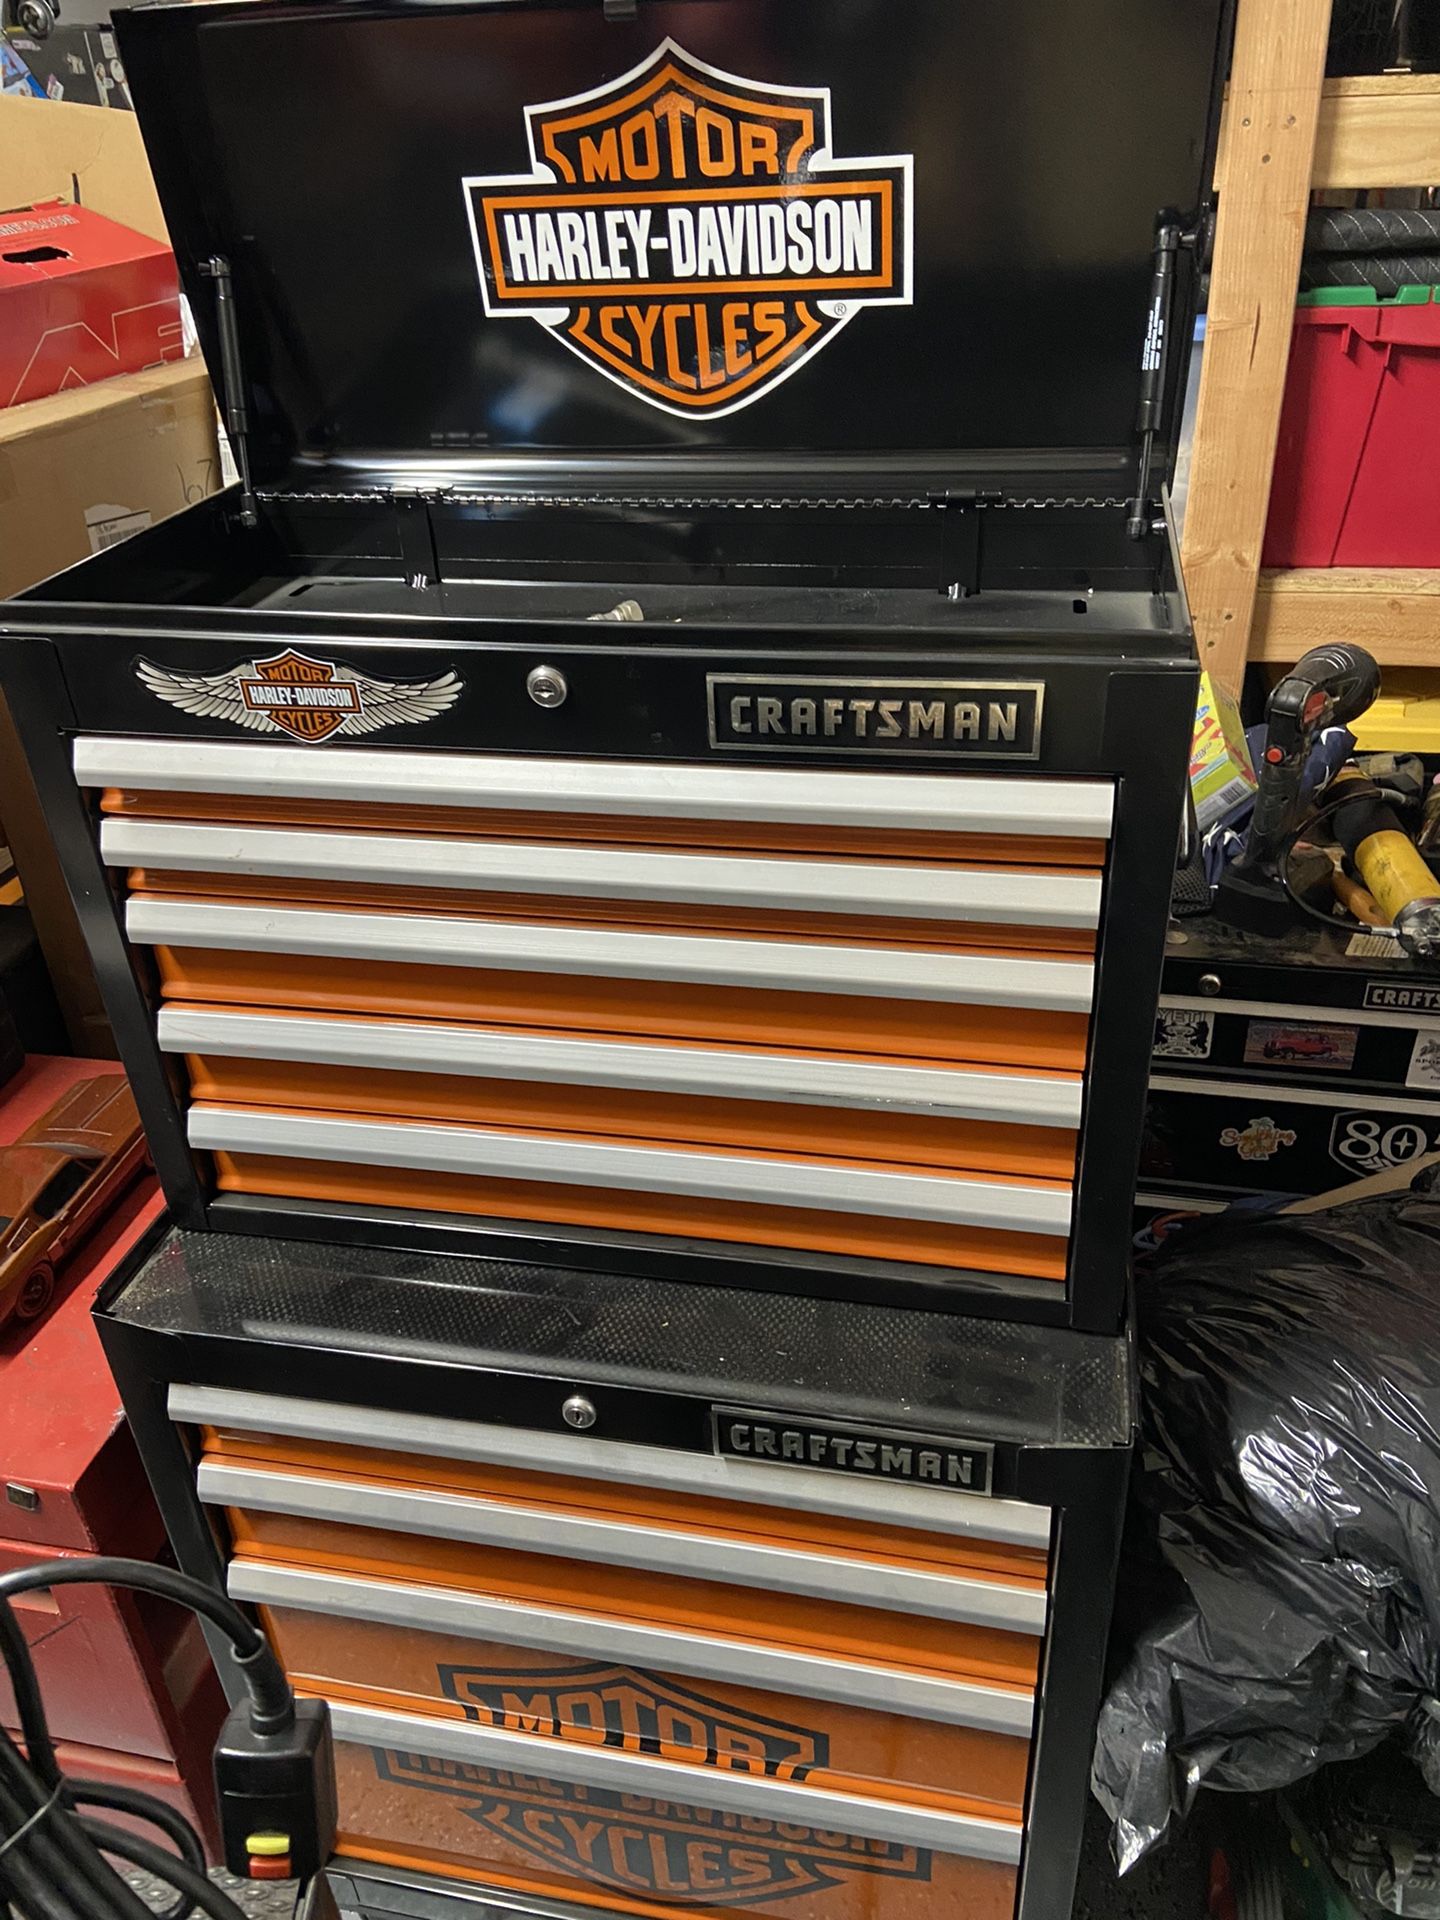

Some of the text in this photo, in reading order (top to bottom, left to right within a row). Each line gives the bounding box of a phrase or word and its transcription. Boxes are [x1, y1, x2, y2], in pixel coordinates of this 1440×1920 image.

[579, 91, 780, 182] MOTOR
[503, 199, 873, 282] HARLEY-DAVIDSON
[599, 300, 787, 390] CYCLES
[248, 685, 352, 707] HARLEY-DAVIDSON
[267, 662, 322, 682] MOTOR
[279, 711, 332, 734] CYCLES
[729, 695, 1018, 741] CRAFTSMAN
[1157, 1009, 1206, 1023] YETI
[730, 1423, 973, 1484] CRAFTSMAN
[501, 1684, 767, 1777] MOTOR
[522, 1809, 773, 1891] CYCLES
